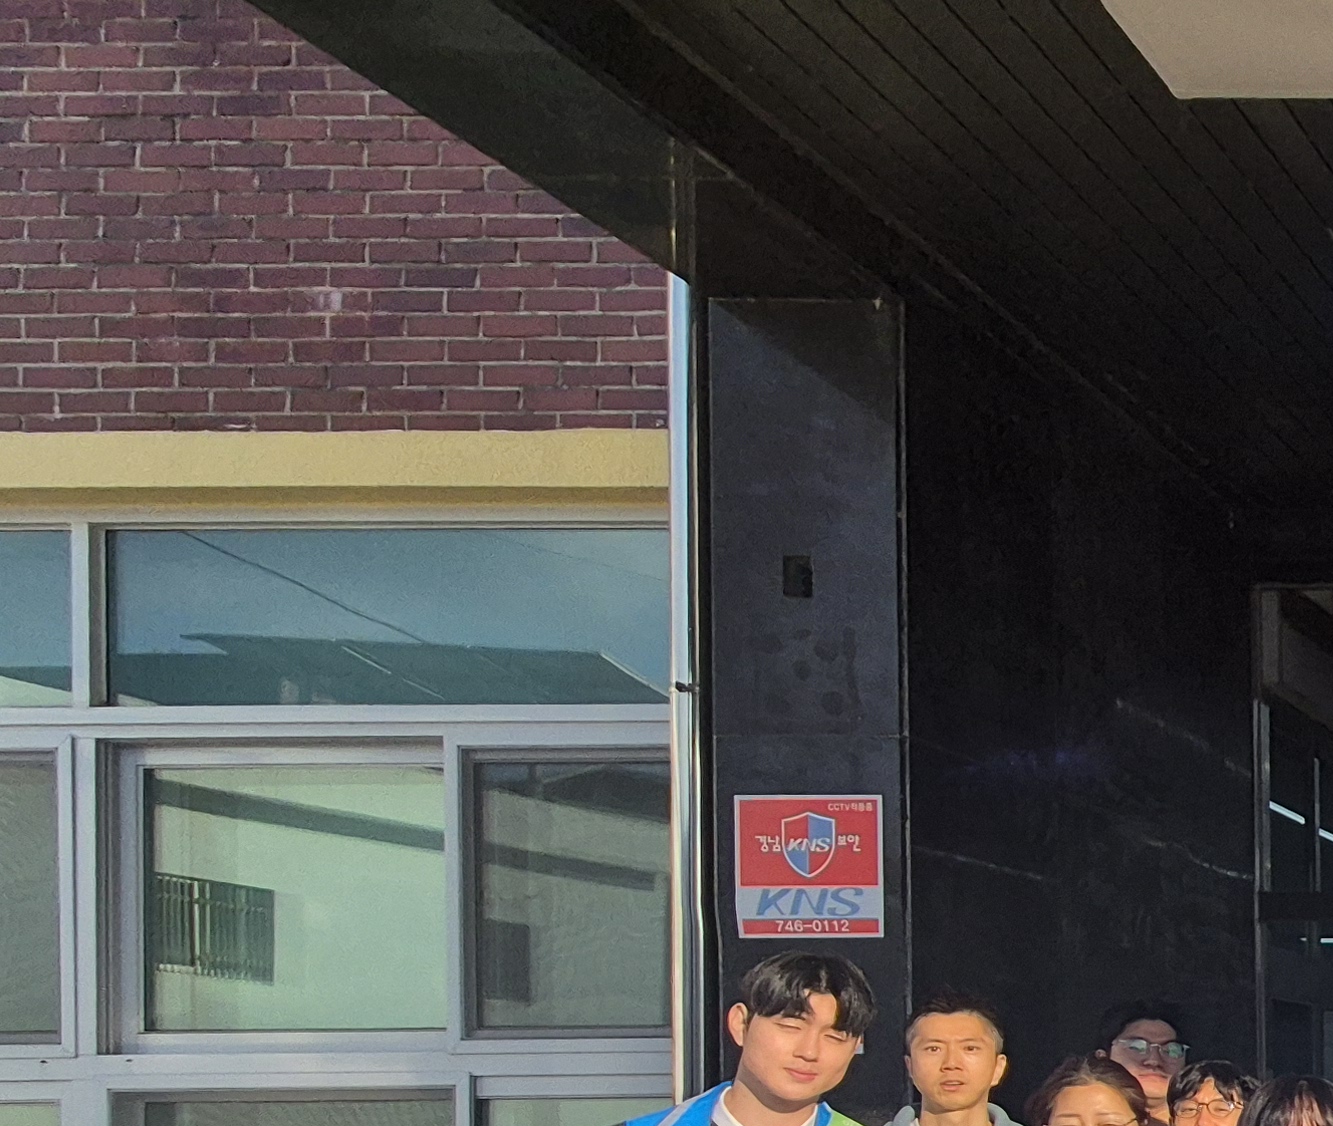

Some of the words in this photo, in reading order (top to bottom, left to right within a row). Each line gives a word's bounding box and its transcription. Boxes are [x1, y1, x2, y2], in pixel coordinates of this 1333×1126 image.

[755, 835, 781, 852] 경남
[787, 838, 831, 852] KNS
[837, 834, 861, 852] 보안
[756, 887, 864, 917] KNS
[775, 920, 850, 932] 746-0112
